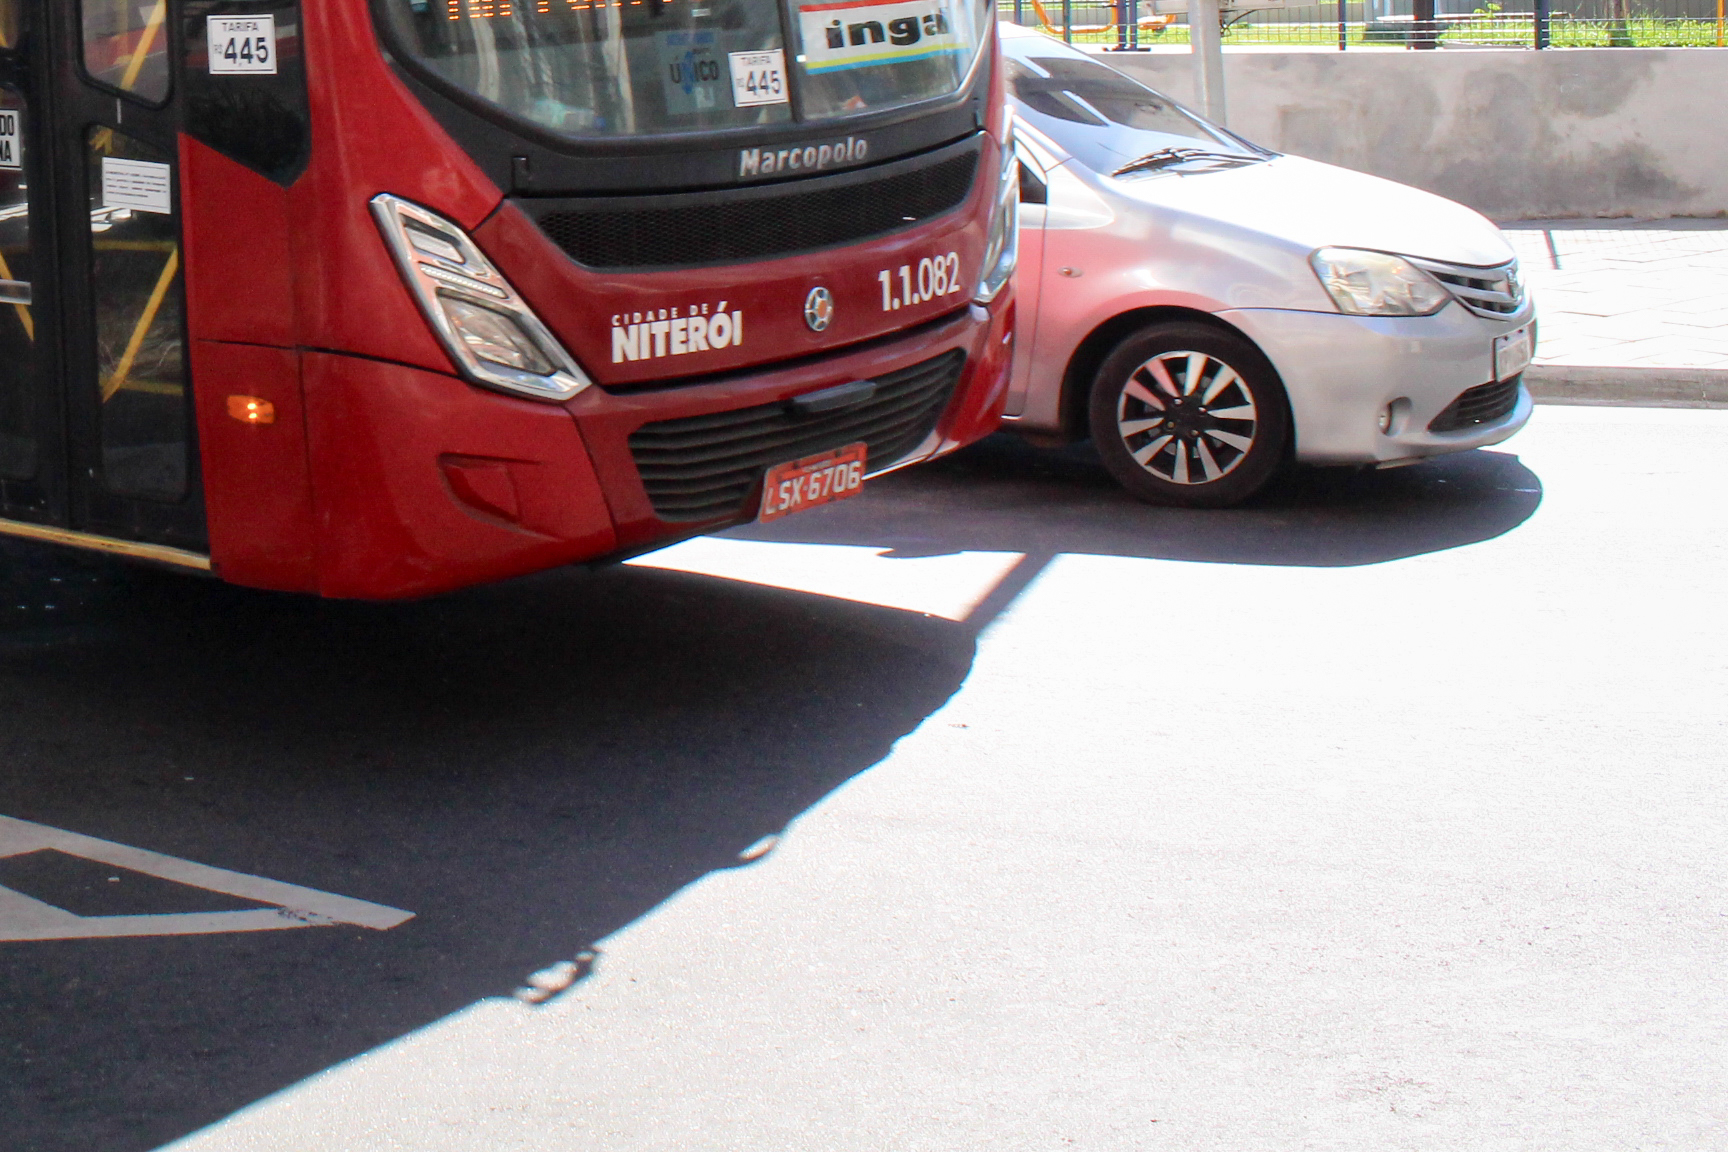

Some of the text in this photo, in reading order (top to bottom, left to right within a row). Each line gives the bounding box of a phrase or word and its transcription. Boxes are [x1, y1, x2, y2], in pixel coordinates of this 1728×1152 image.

[222, 21, 259, 32] TARIFA
[740, 137, 869, 177] Marcopolo
[878, 251, 961, 312] 1.1.082
[611, 303, 709, 326] CIDADE DE
[612, 301, 743, 364] NITERÓI
